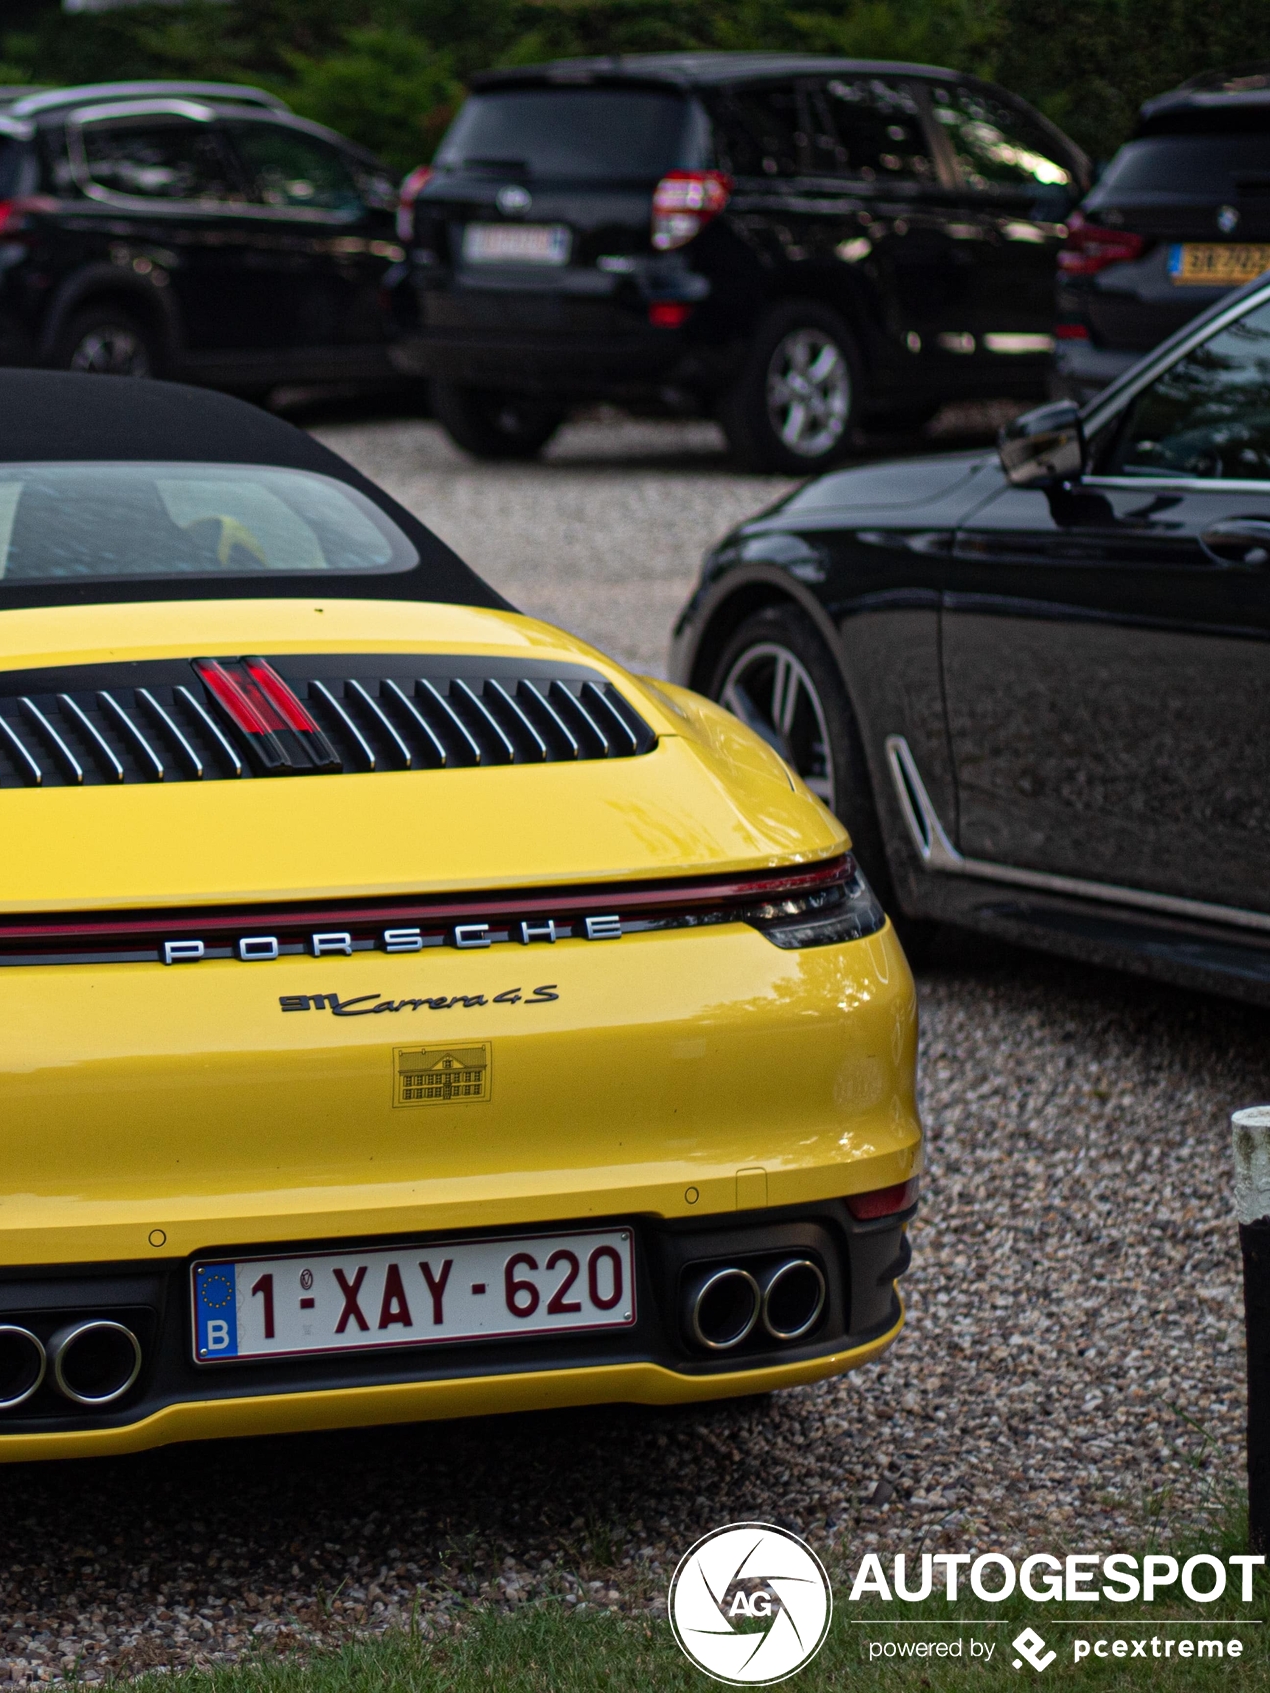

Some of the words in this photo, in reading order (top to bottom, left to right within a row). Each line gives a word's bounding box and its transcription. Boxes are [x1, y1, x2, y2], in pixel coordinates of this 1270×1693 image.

[163, 915, 621, 964] PORSCHE
[279, 993, 339, 1012] 911
[332, 993, 488, 1016] Carrera
[251, 1245, 623, 1339] 1-XAY-620
[207, 1319, 230, 1350] B
